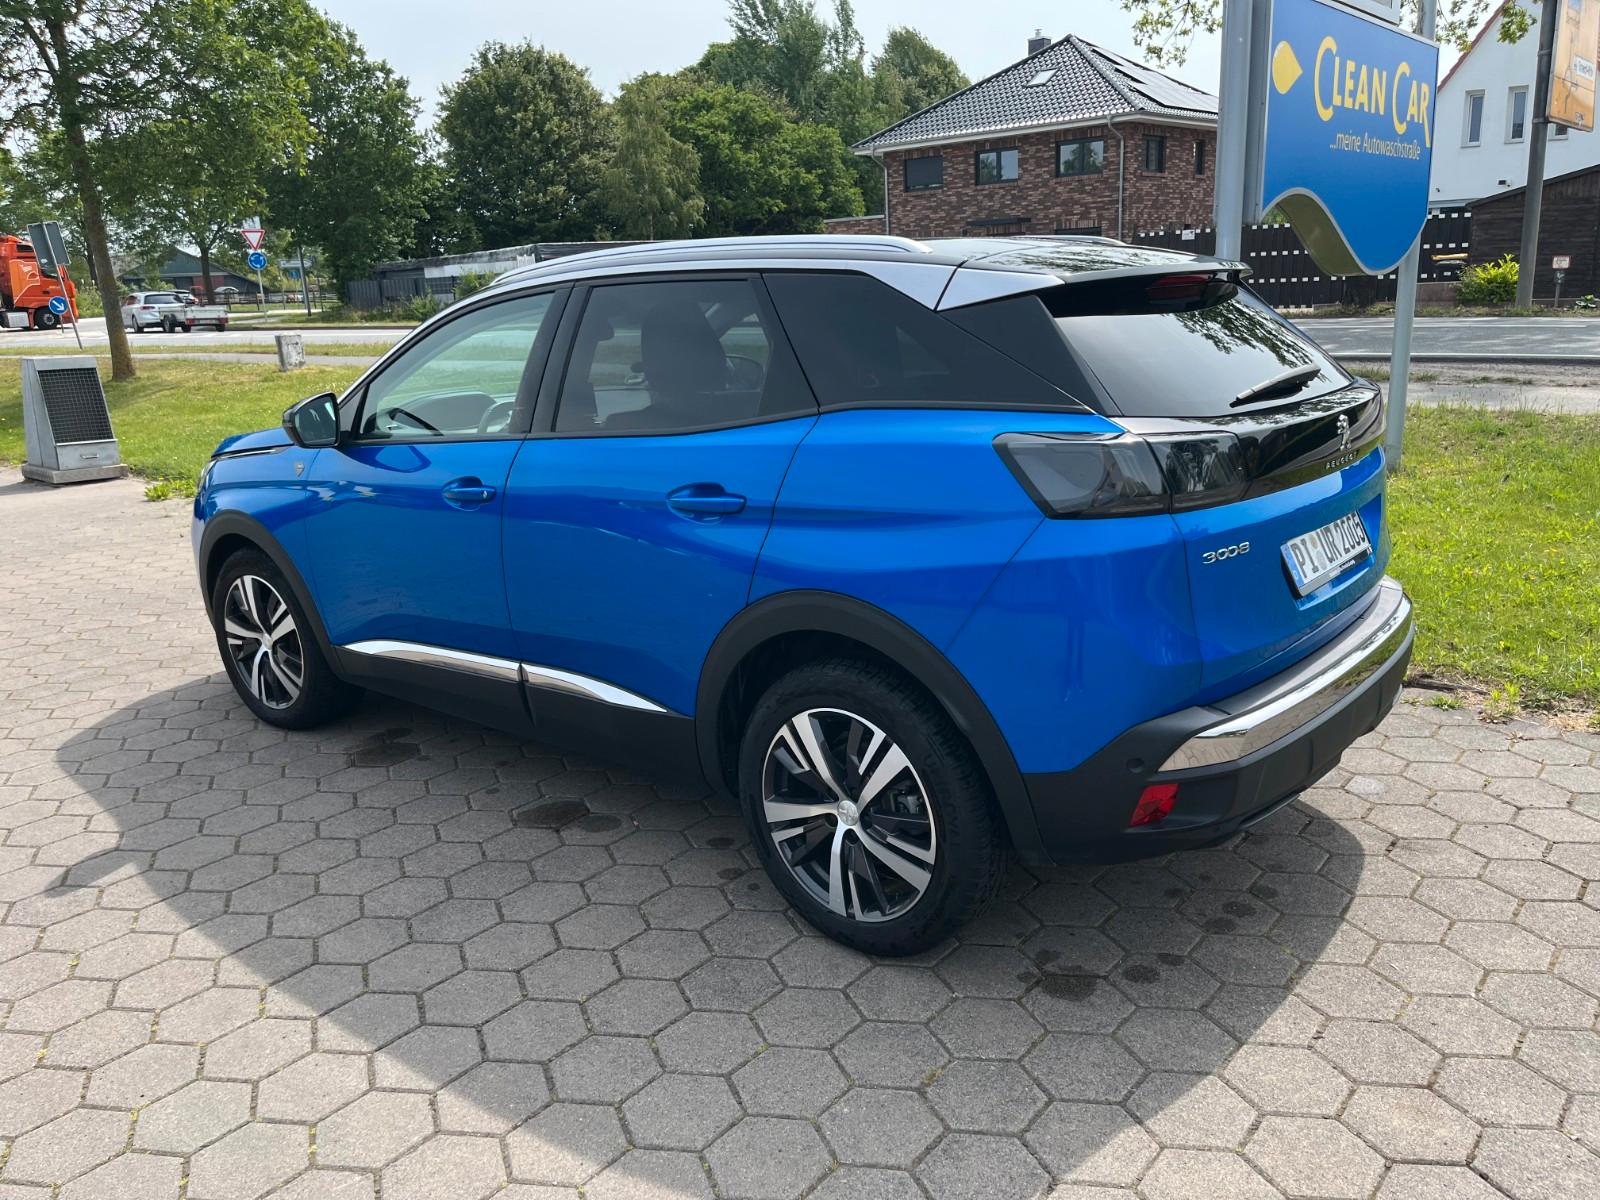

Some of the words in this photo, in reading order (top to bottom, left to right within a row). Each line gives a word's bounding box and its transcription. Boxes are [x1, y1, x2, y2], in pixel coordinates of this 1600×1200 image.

[1314, 36, 1387, 121] CLEAN
[1392, 62, 1431, 148] CAR
[1363, 133, 1421, 160] Autowaschstraße
[1202, 541, 1250, 564] 3008
